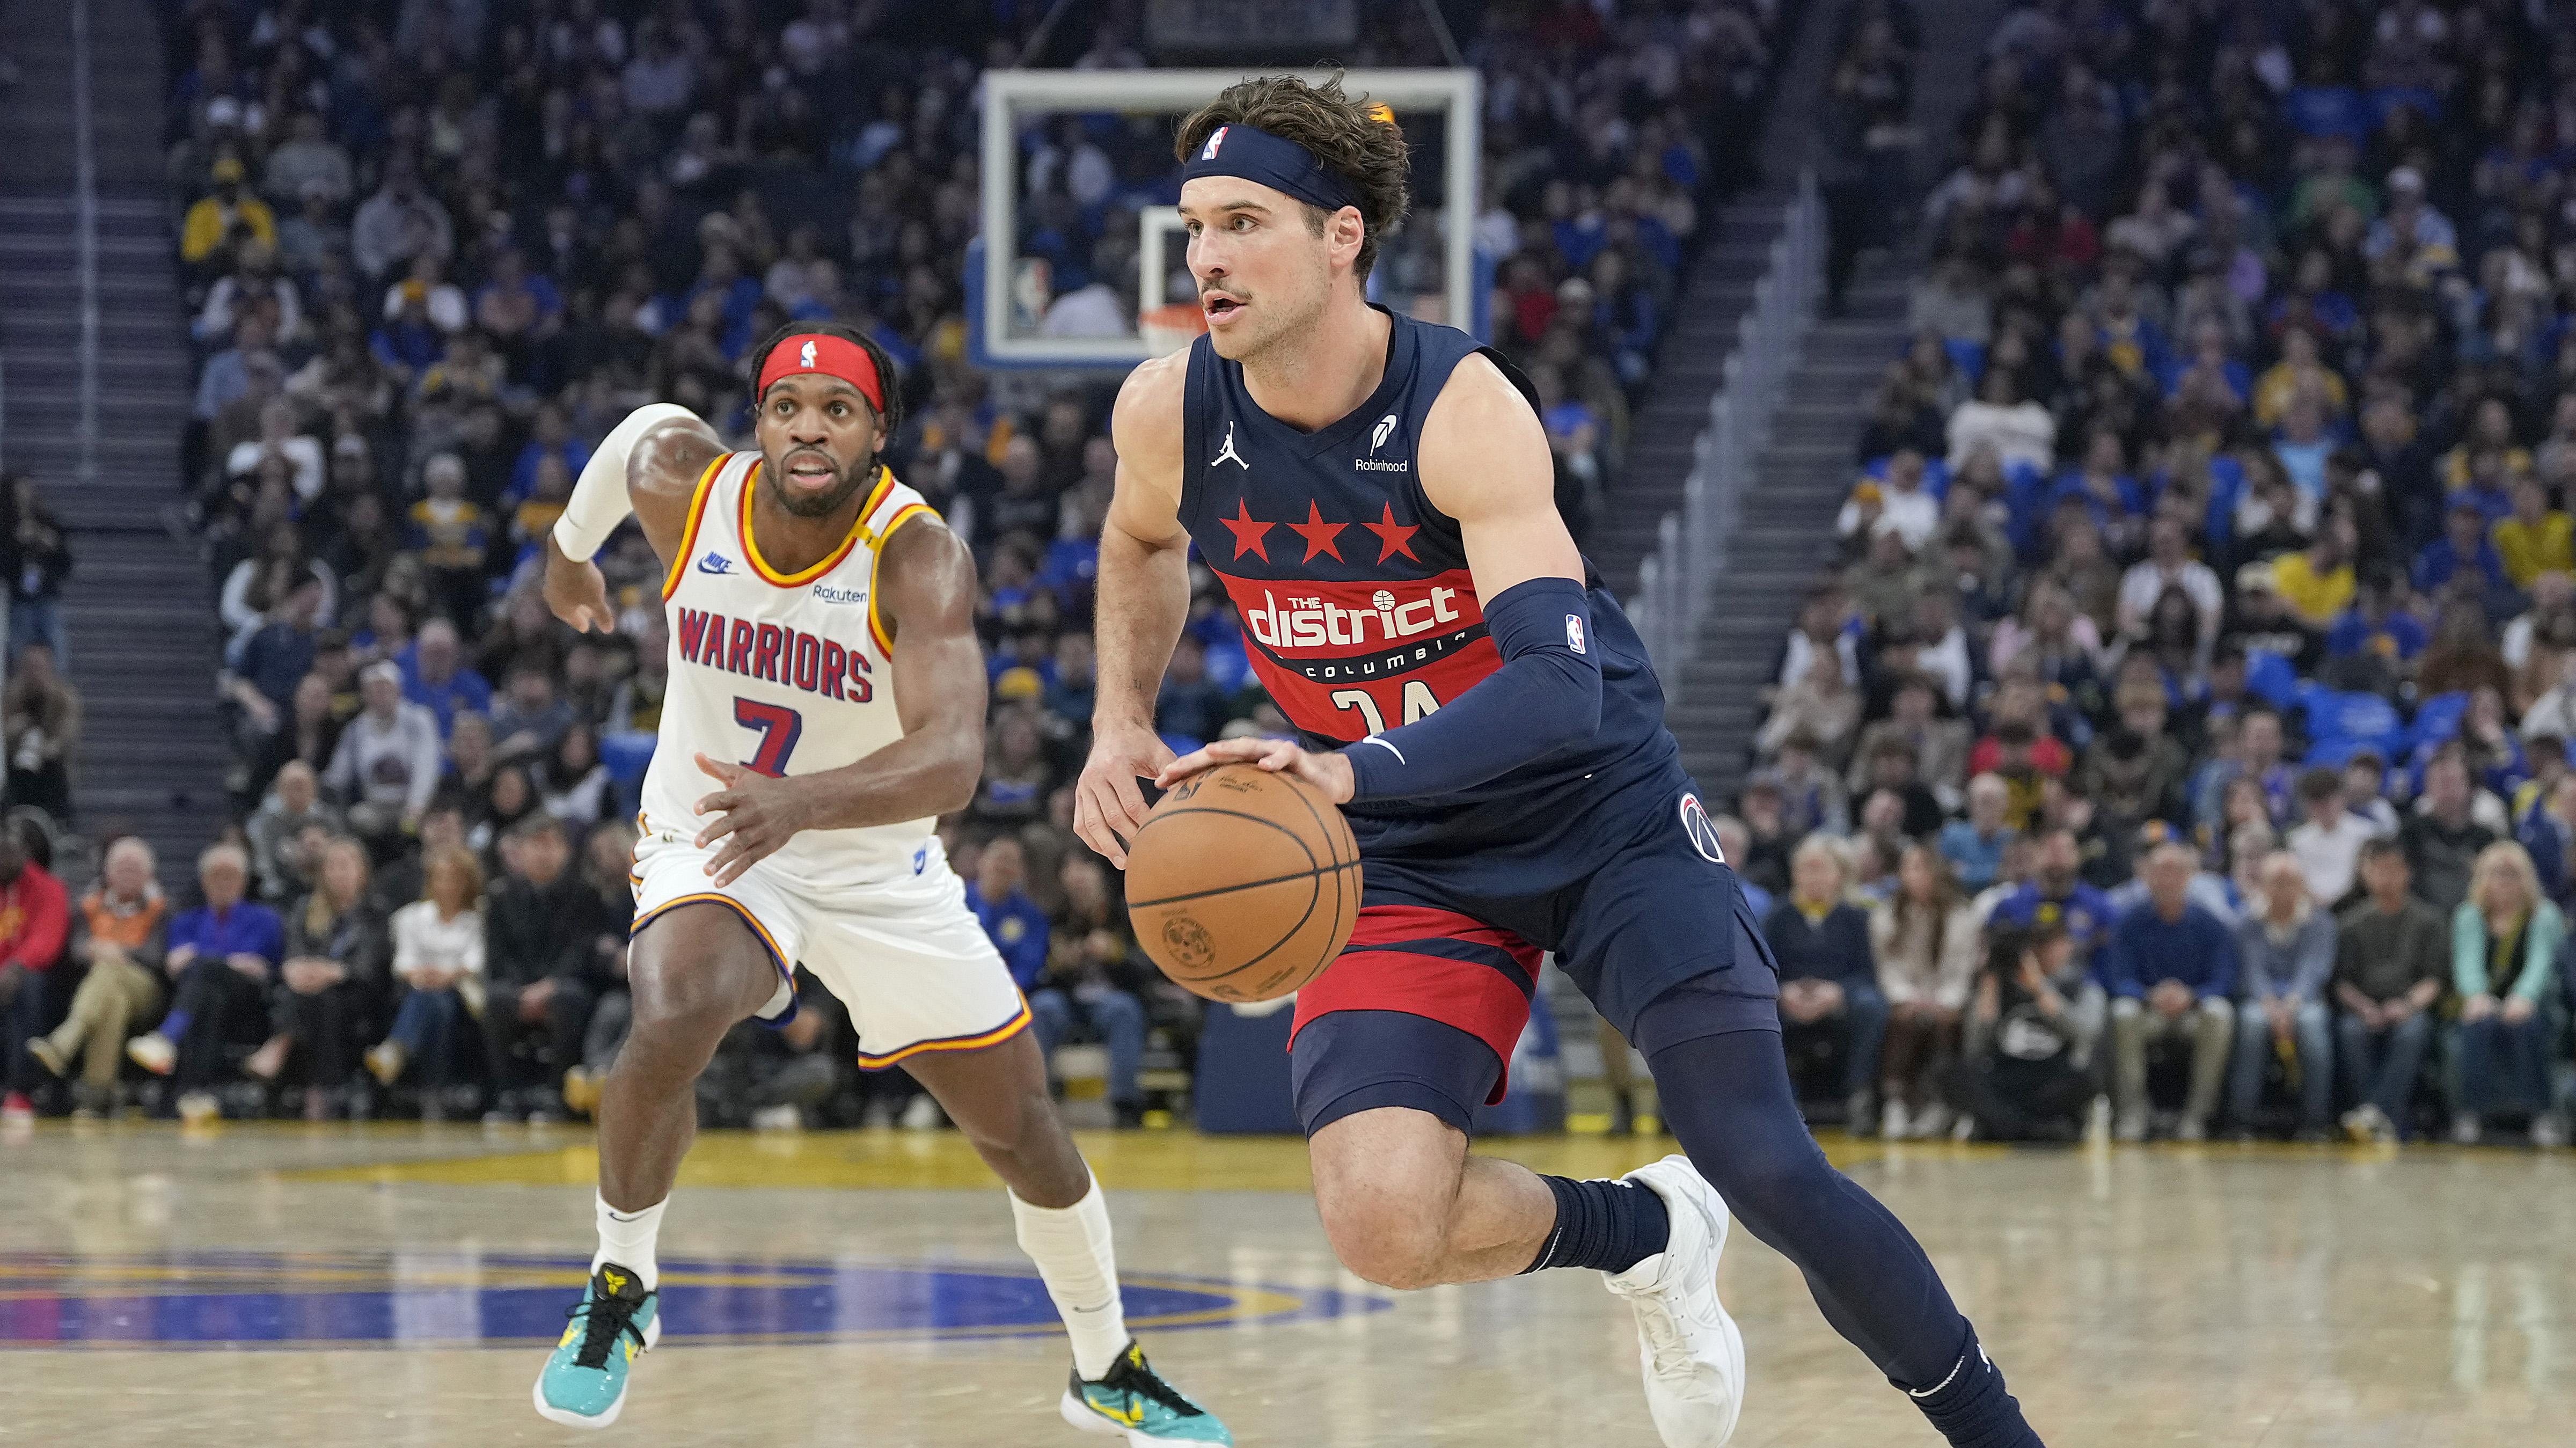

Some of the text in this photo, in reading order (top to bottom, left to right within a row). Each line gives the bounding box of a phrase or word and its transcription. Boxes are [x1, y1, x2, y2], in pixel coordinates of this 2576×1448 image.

[1355, 459, 1407, 472] Robinhood
[813, 585, 867, 602] Rakuten
[1288, 597, 1321, 609] THE
[1248, 587, 1459, 647] district
[678, 607, 872, 703] WARRIORS
[1306, 632, 1465, 677] COLUMBIA
[733, 696, 802, 778] 7
